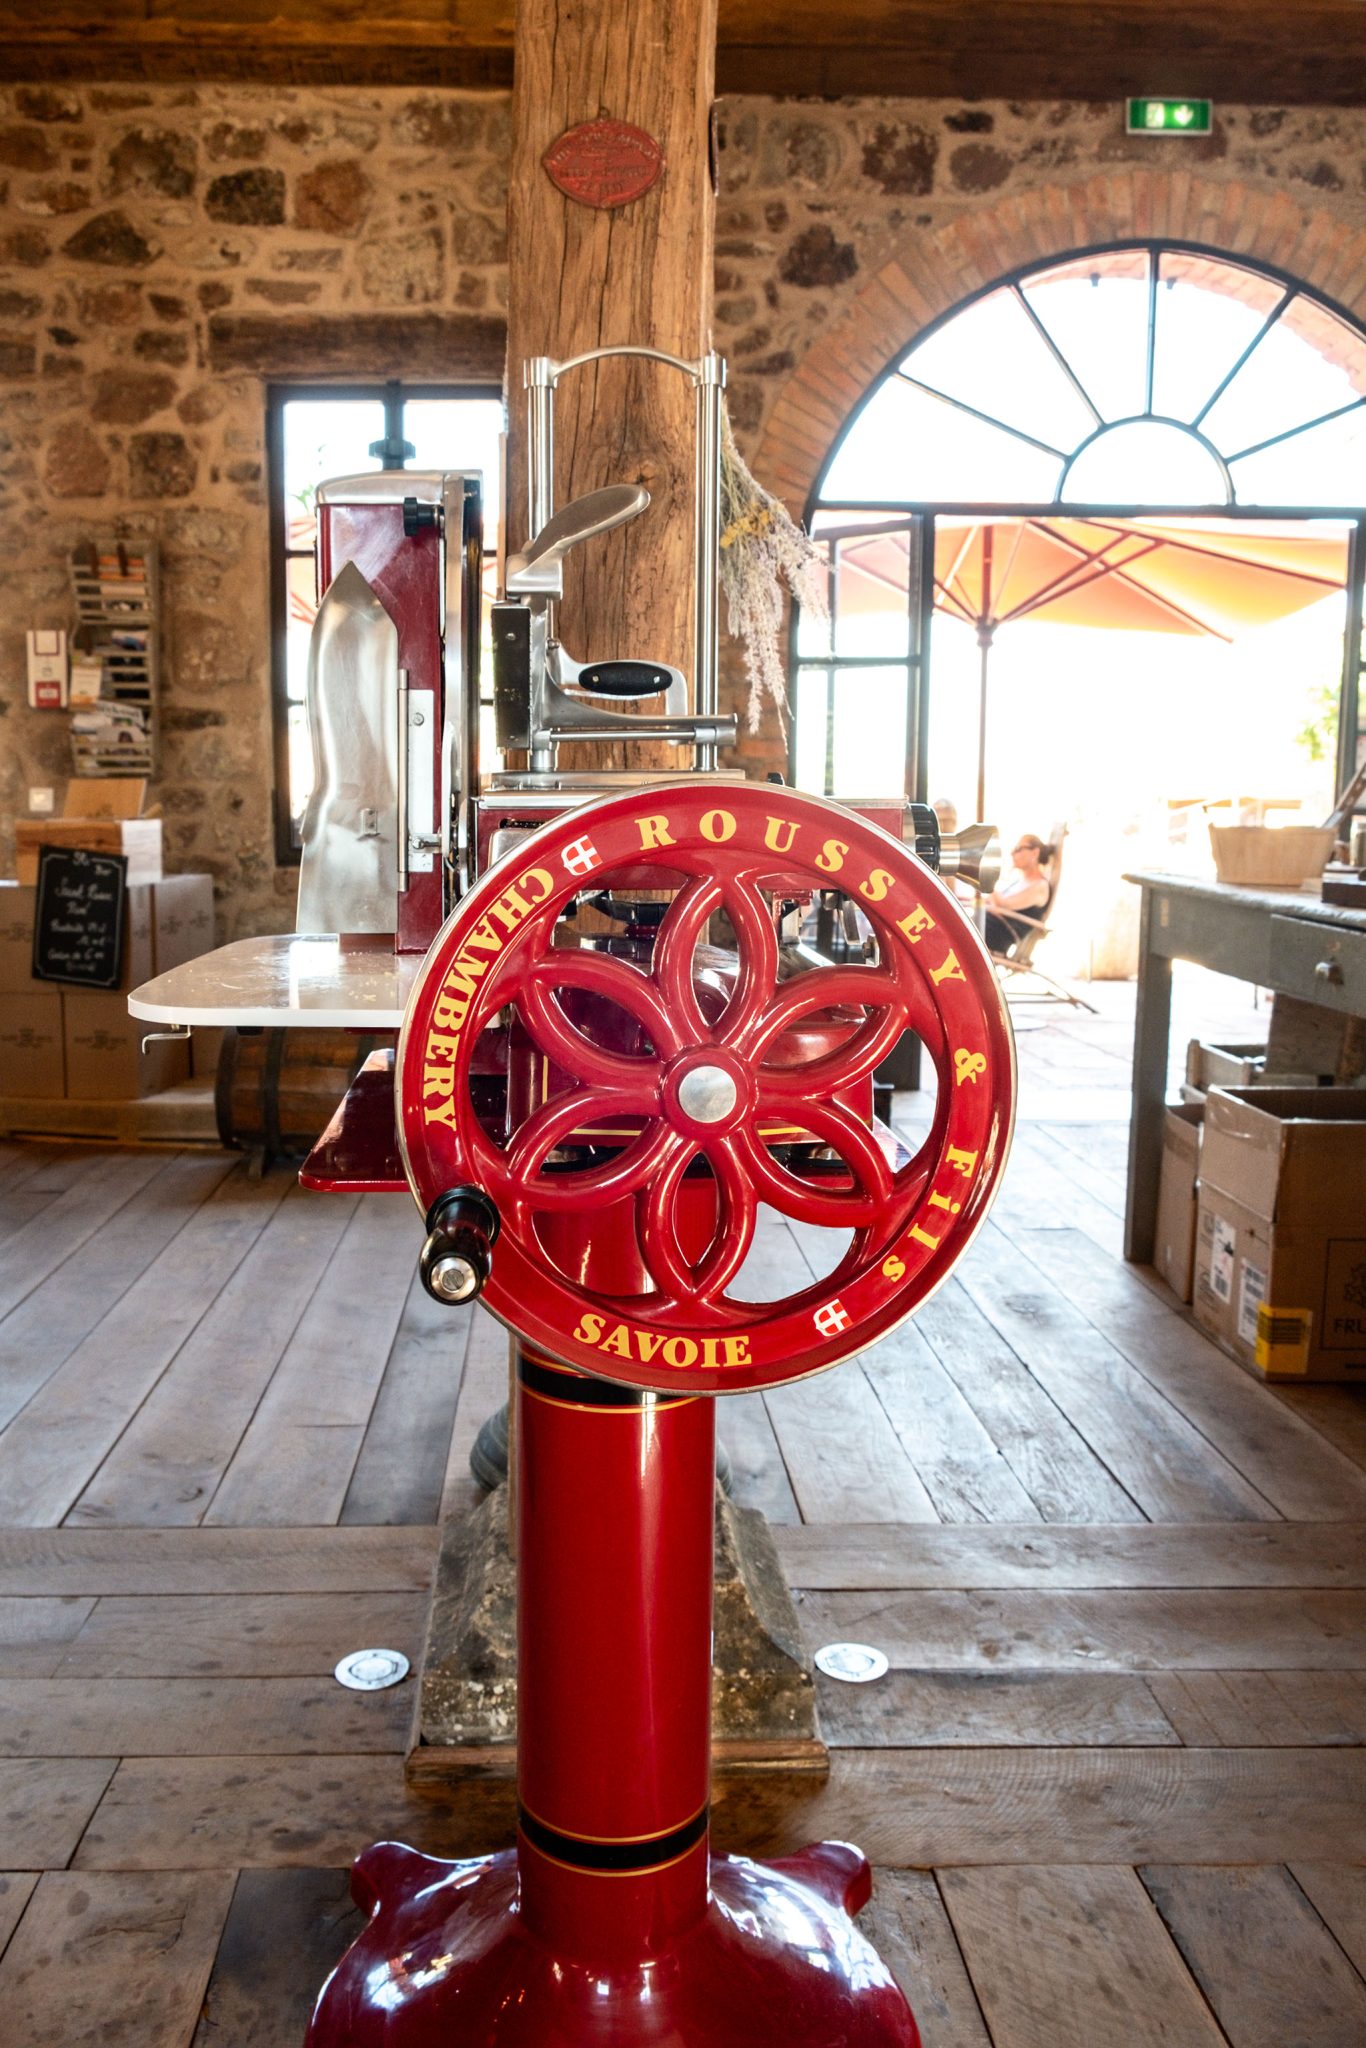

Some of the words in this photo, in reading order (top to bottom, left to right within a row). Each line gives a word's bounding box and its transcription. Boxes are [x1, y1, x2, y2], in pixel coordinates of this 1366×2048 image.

[423, 867, 554, 1132] CHAMBERY
[635, 809, 967, 987] ROUSSEY
[953, 1047, 987, 1086] &
[572, 1312, 752, 1369] SAVOIE
